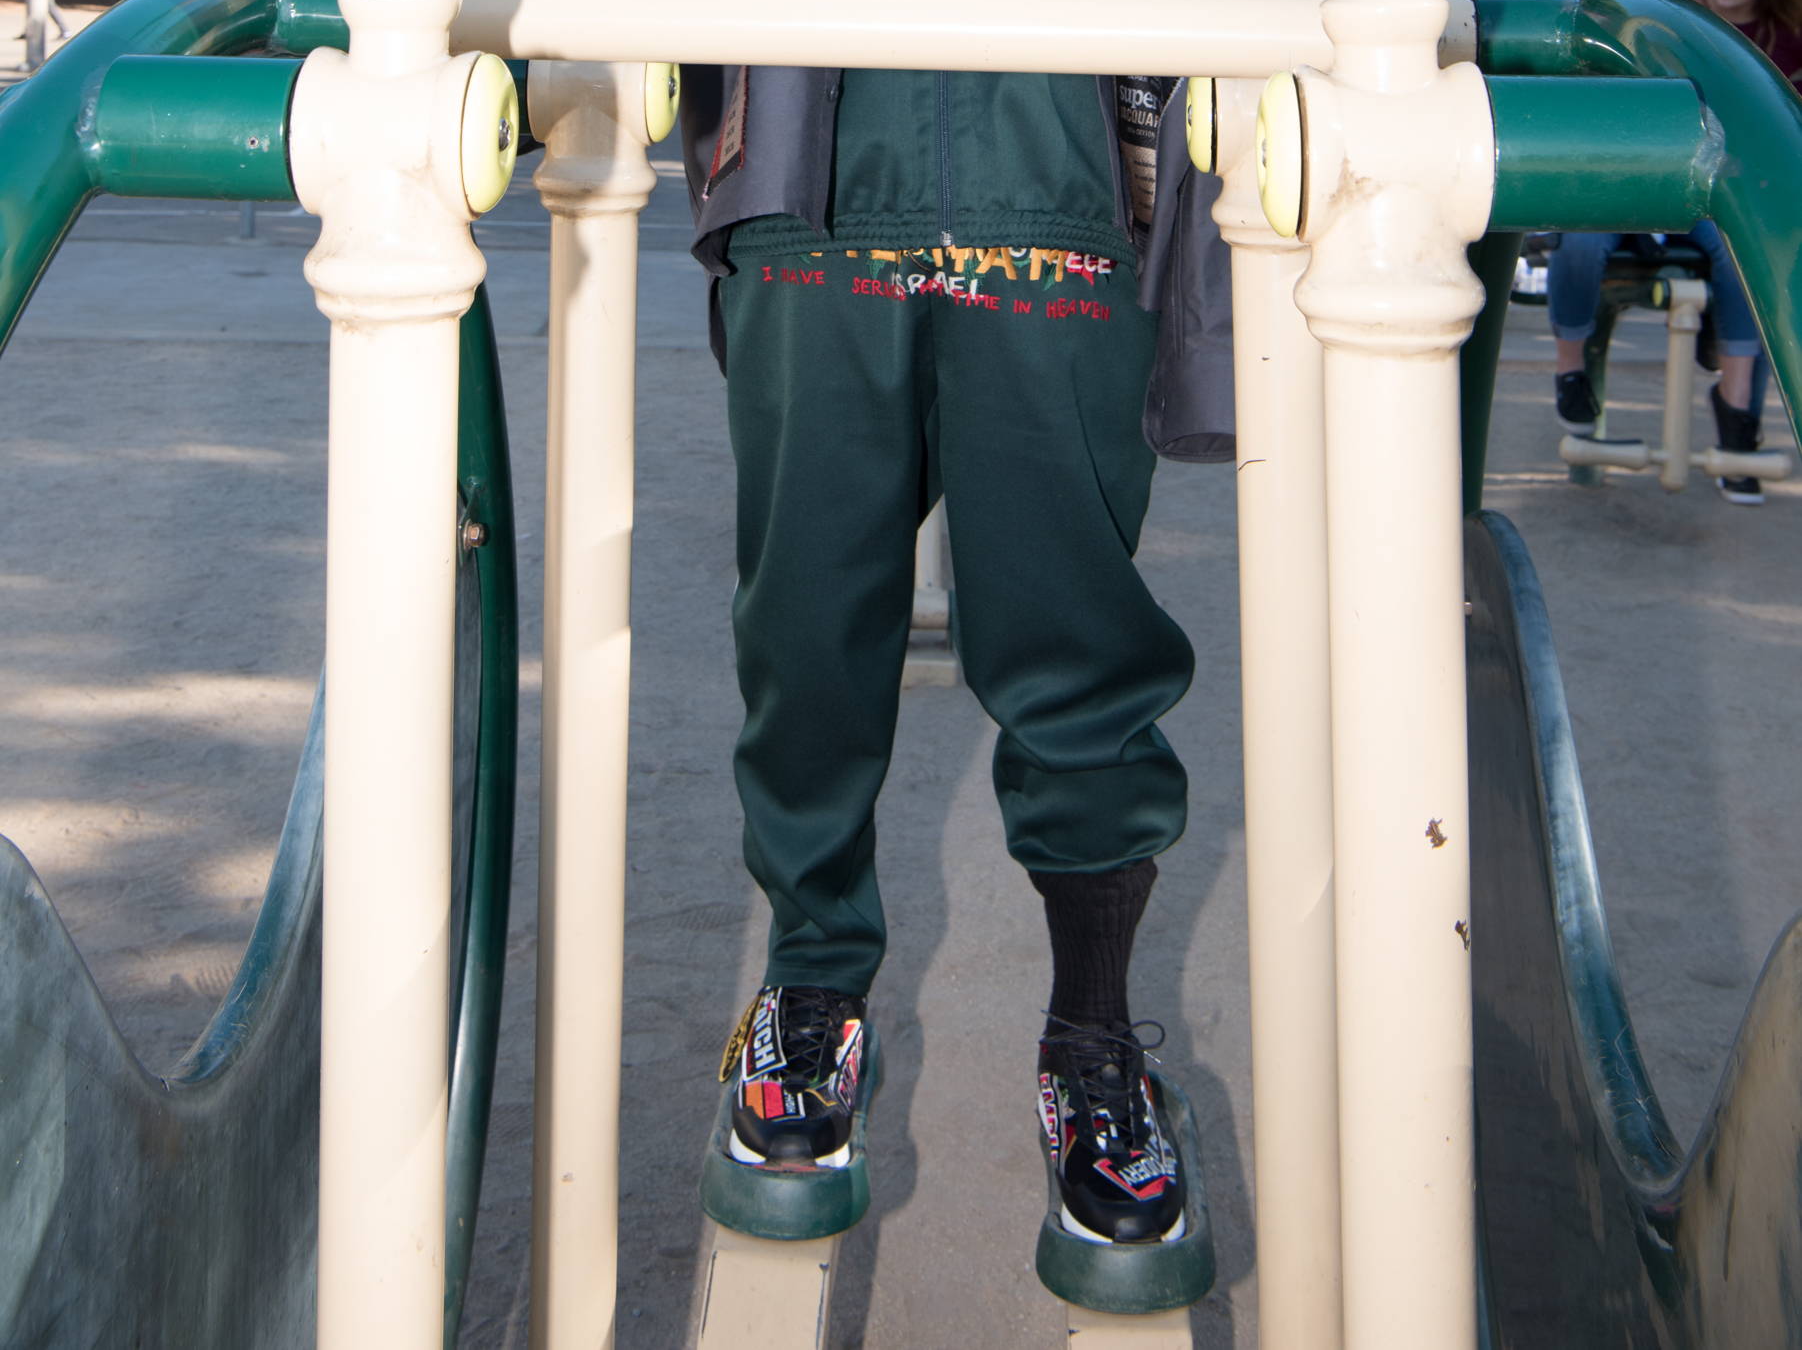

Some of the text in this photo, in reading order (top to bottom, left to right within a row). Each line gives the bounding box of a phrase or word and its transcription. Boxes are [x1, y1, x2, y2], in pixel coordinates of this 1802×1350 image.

[762, 266, 773, 282] I
[780, 268, 826, 285] HAVE
[1013, 299, 1032, 315] IN
[1046, 297, 1112, 323] HEAVEN
